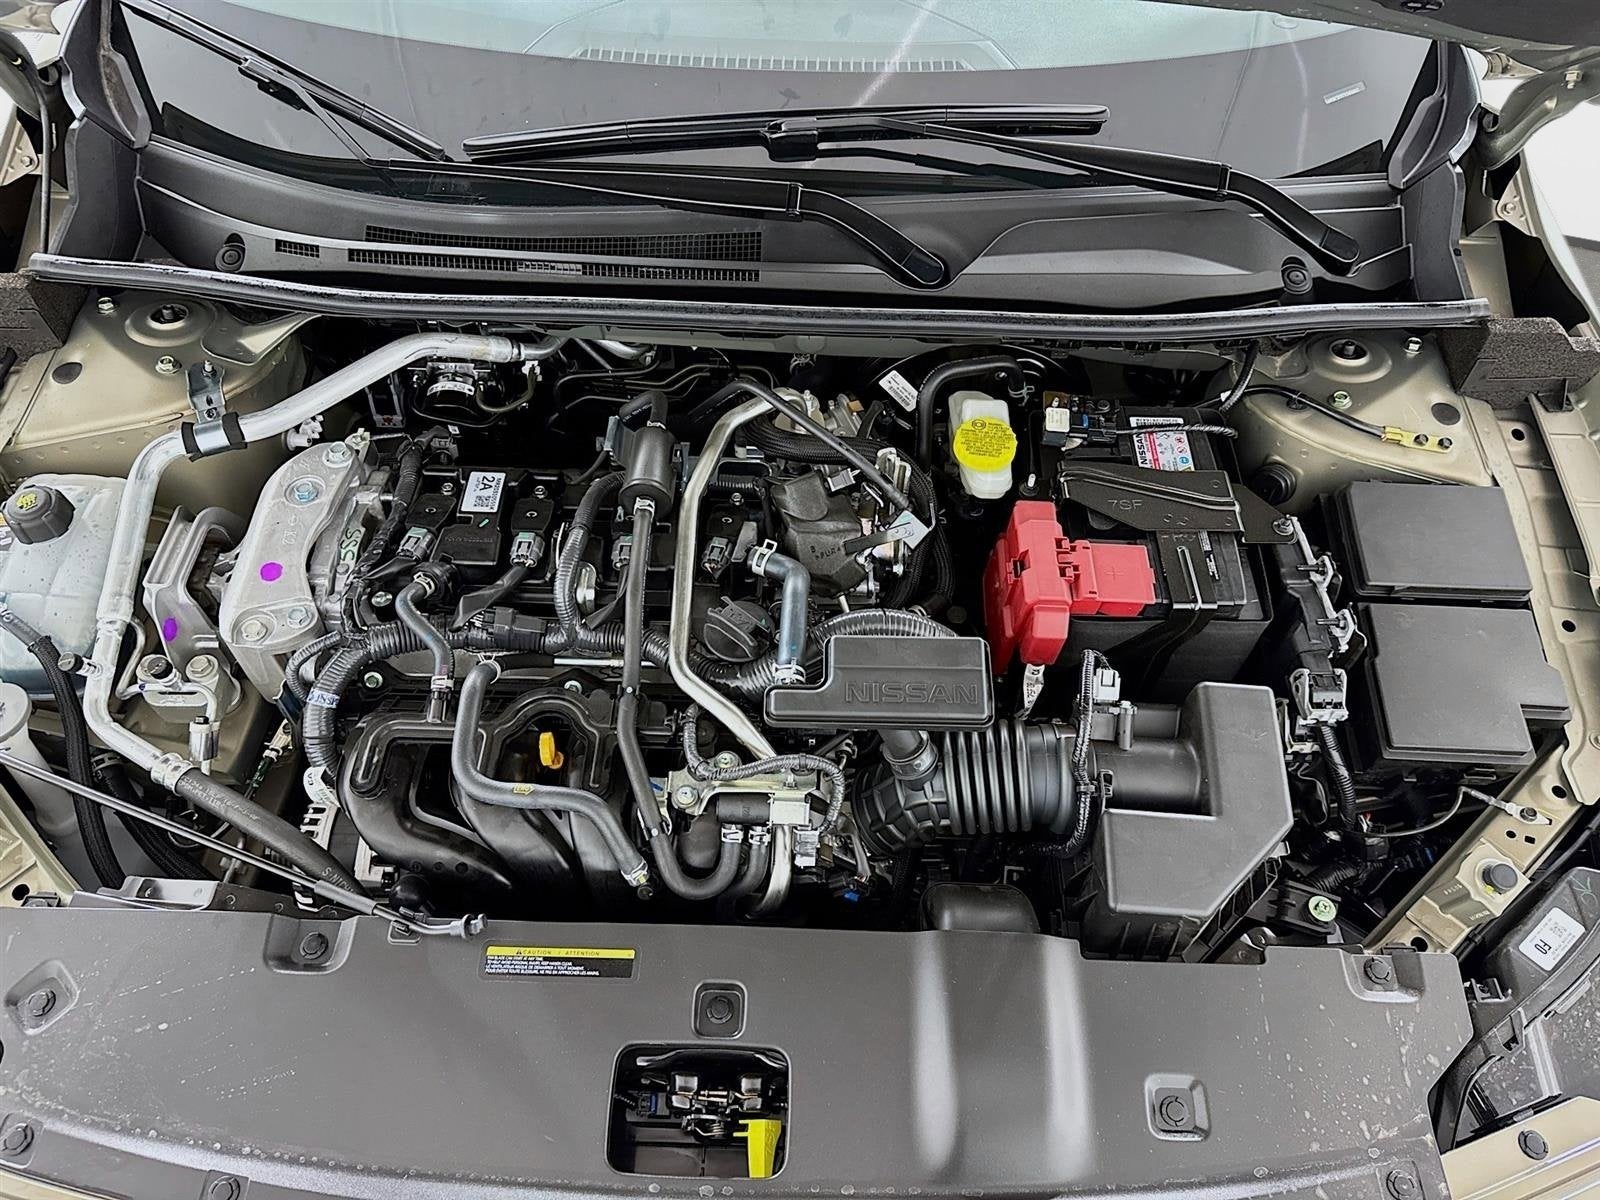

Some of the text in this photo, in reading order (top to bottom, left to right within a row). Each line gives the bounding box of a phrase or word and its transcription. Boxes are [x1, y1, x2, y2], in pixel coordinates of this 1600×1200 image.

[480, 476, 496, 491] 2A
[1107, 499, 1143, 510] 7SF
[845, 681, 978, 704] NISSAN
